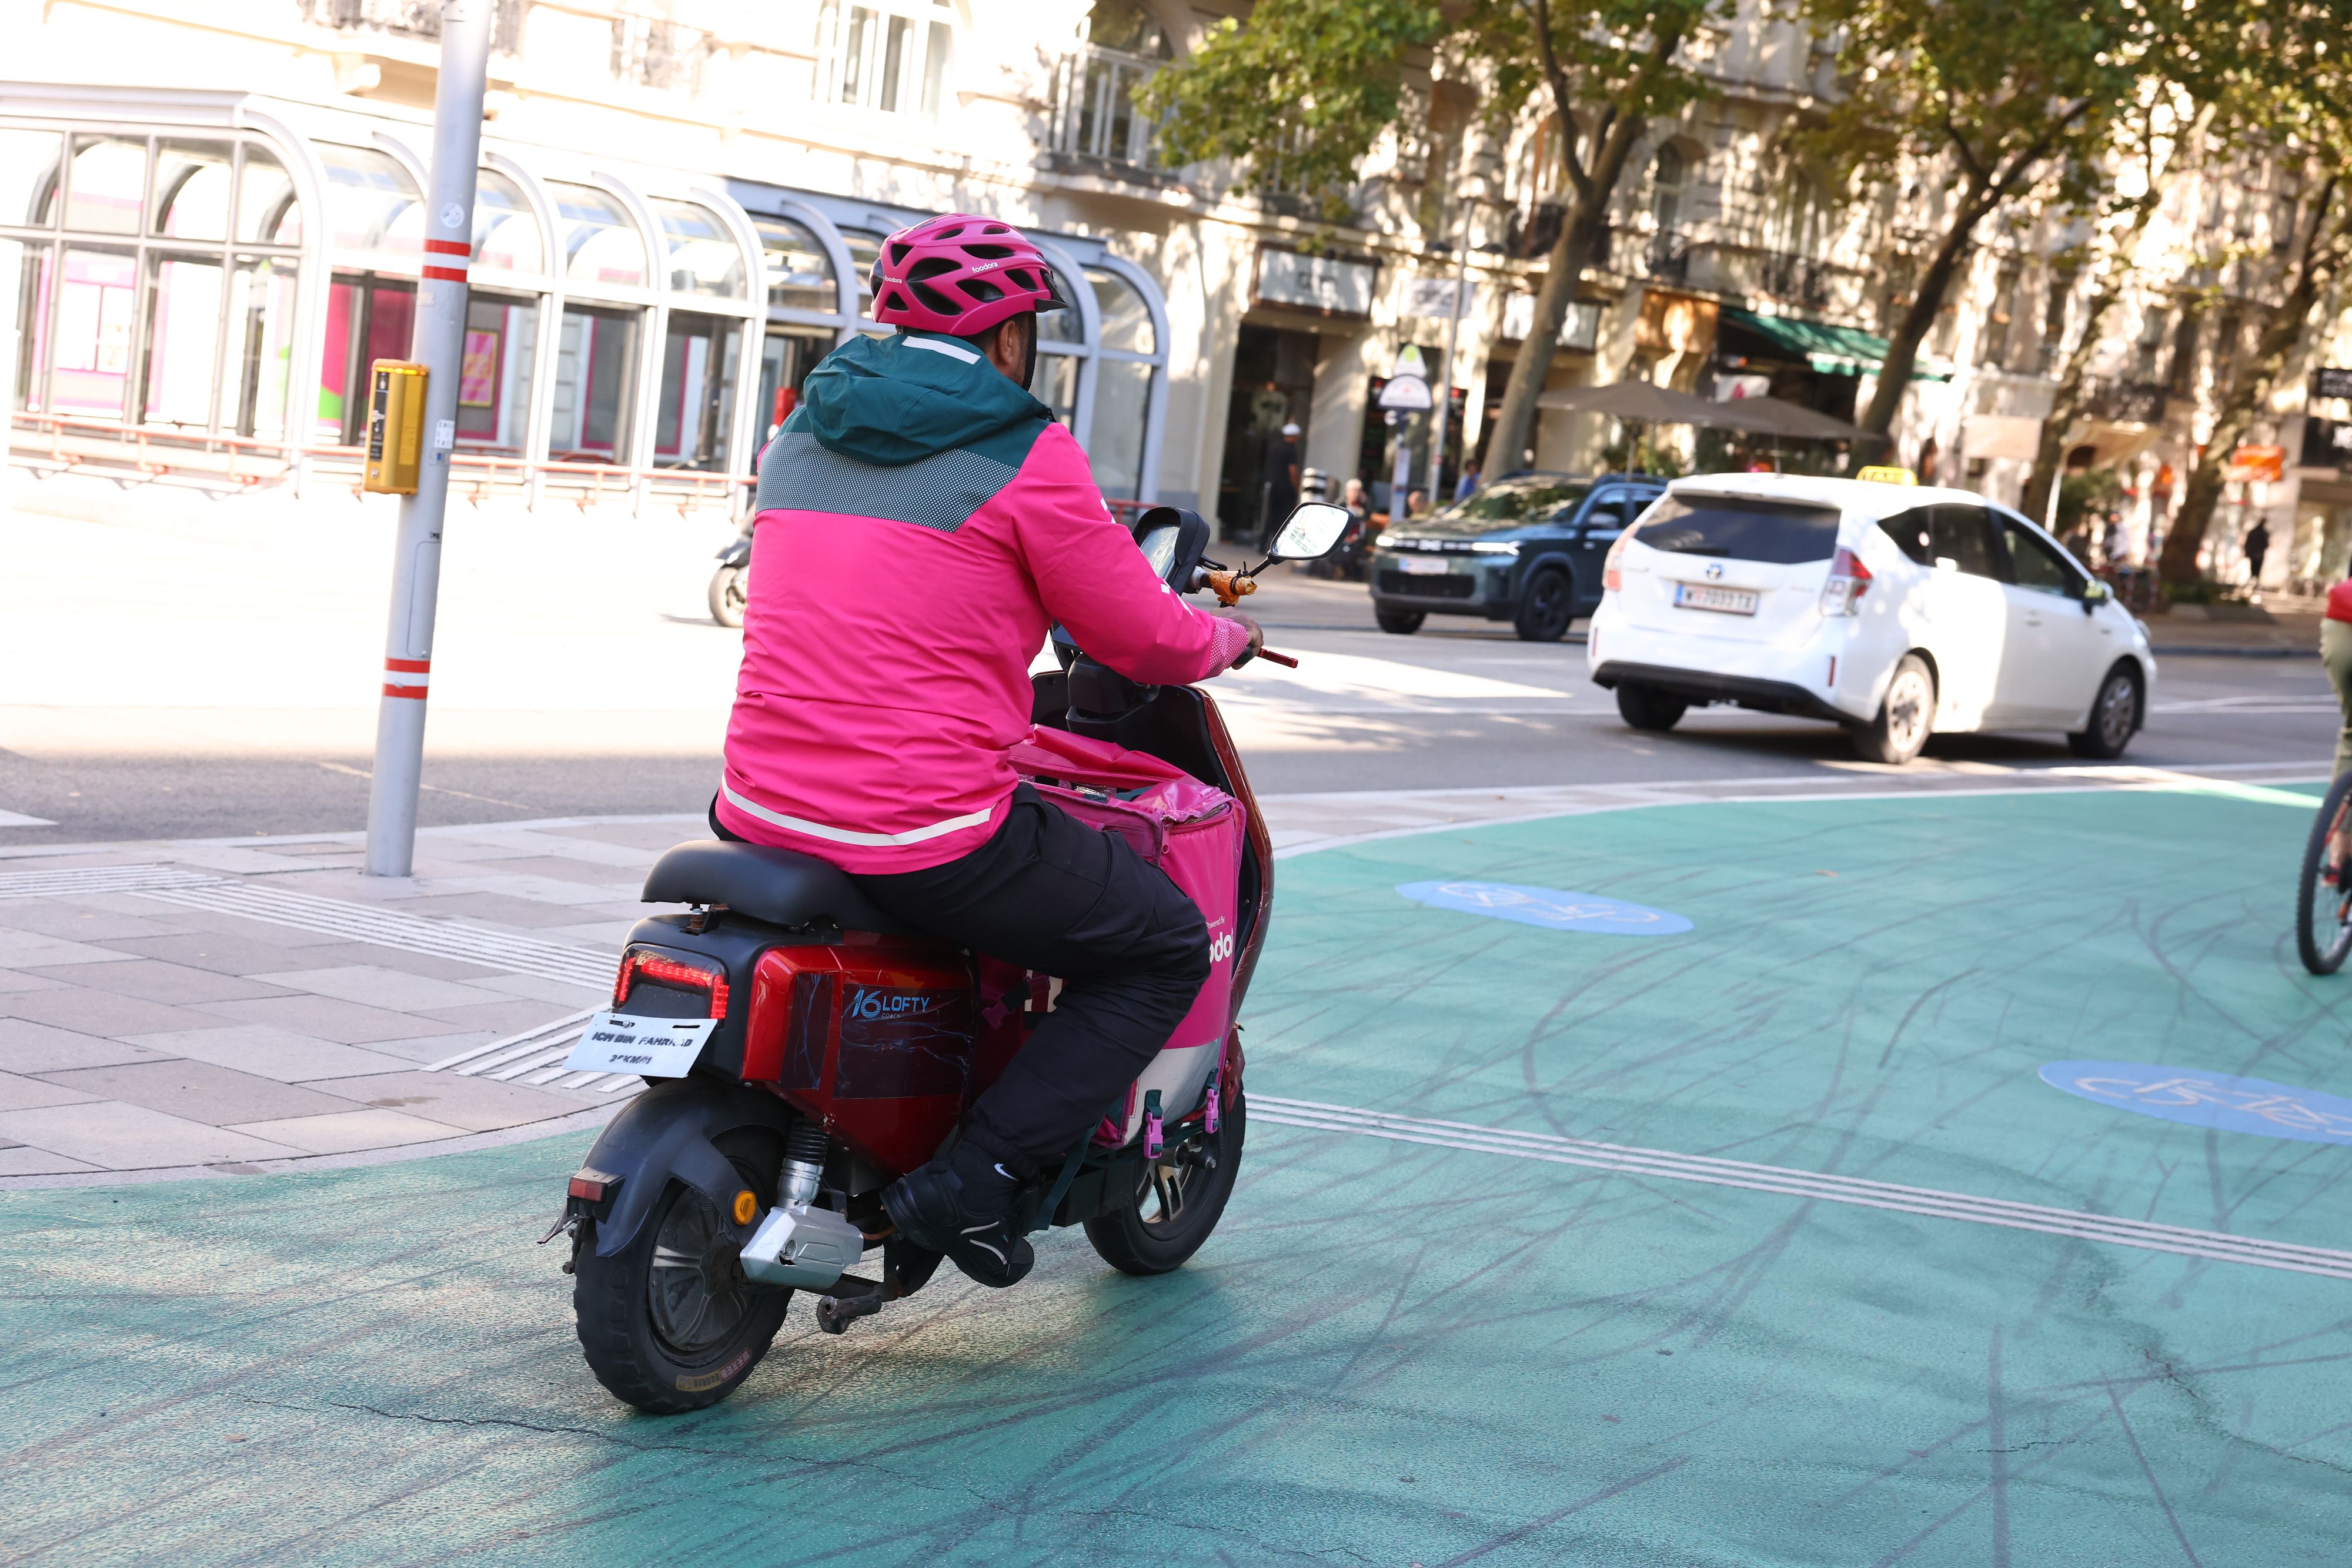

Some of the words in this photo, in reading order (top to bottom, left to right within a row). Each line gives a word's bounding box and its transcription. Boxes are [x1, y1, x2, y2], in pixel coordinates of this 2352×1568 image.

[971, 261, 998, 273] foodora
[884, 275, 903, 284] foodora
[1206, 918, 1221, 930] Powered
[1220, 915, 1225, 925] By
[1208, 927, 1234, 964] odo
[883, 996, 930, 1013] LOFTY
[592, 1031, 615, 1042] ICH
[614, 1034, 636, 1044] BIN
